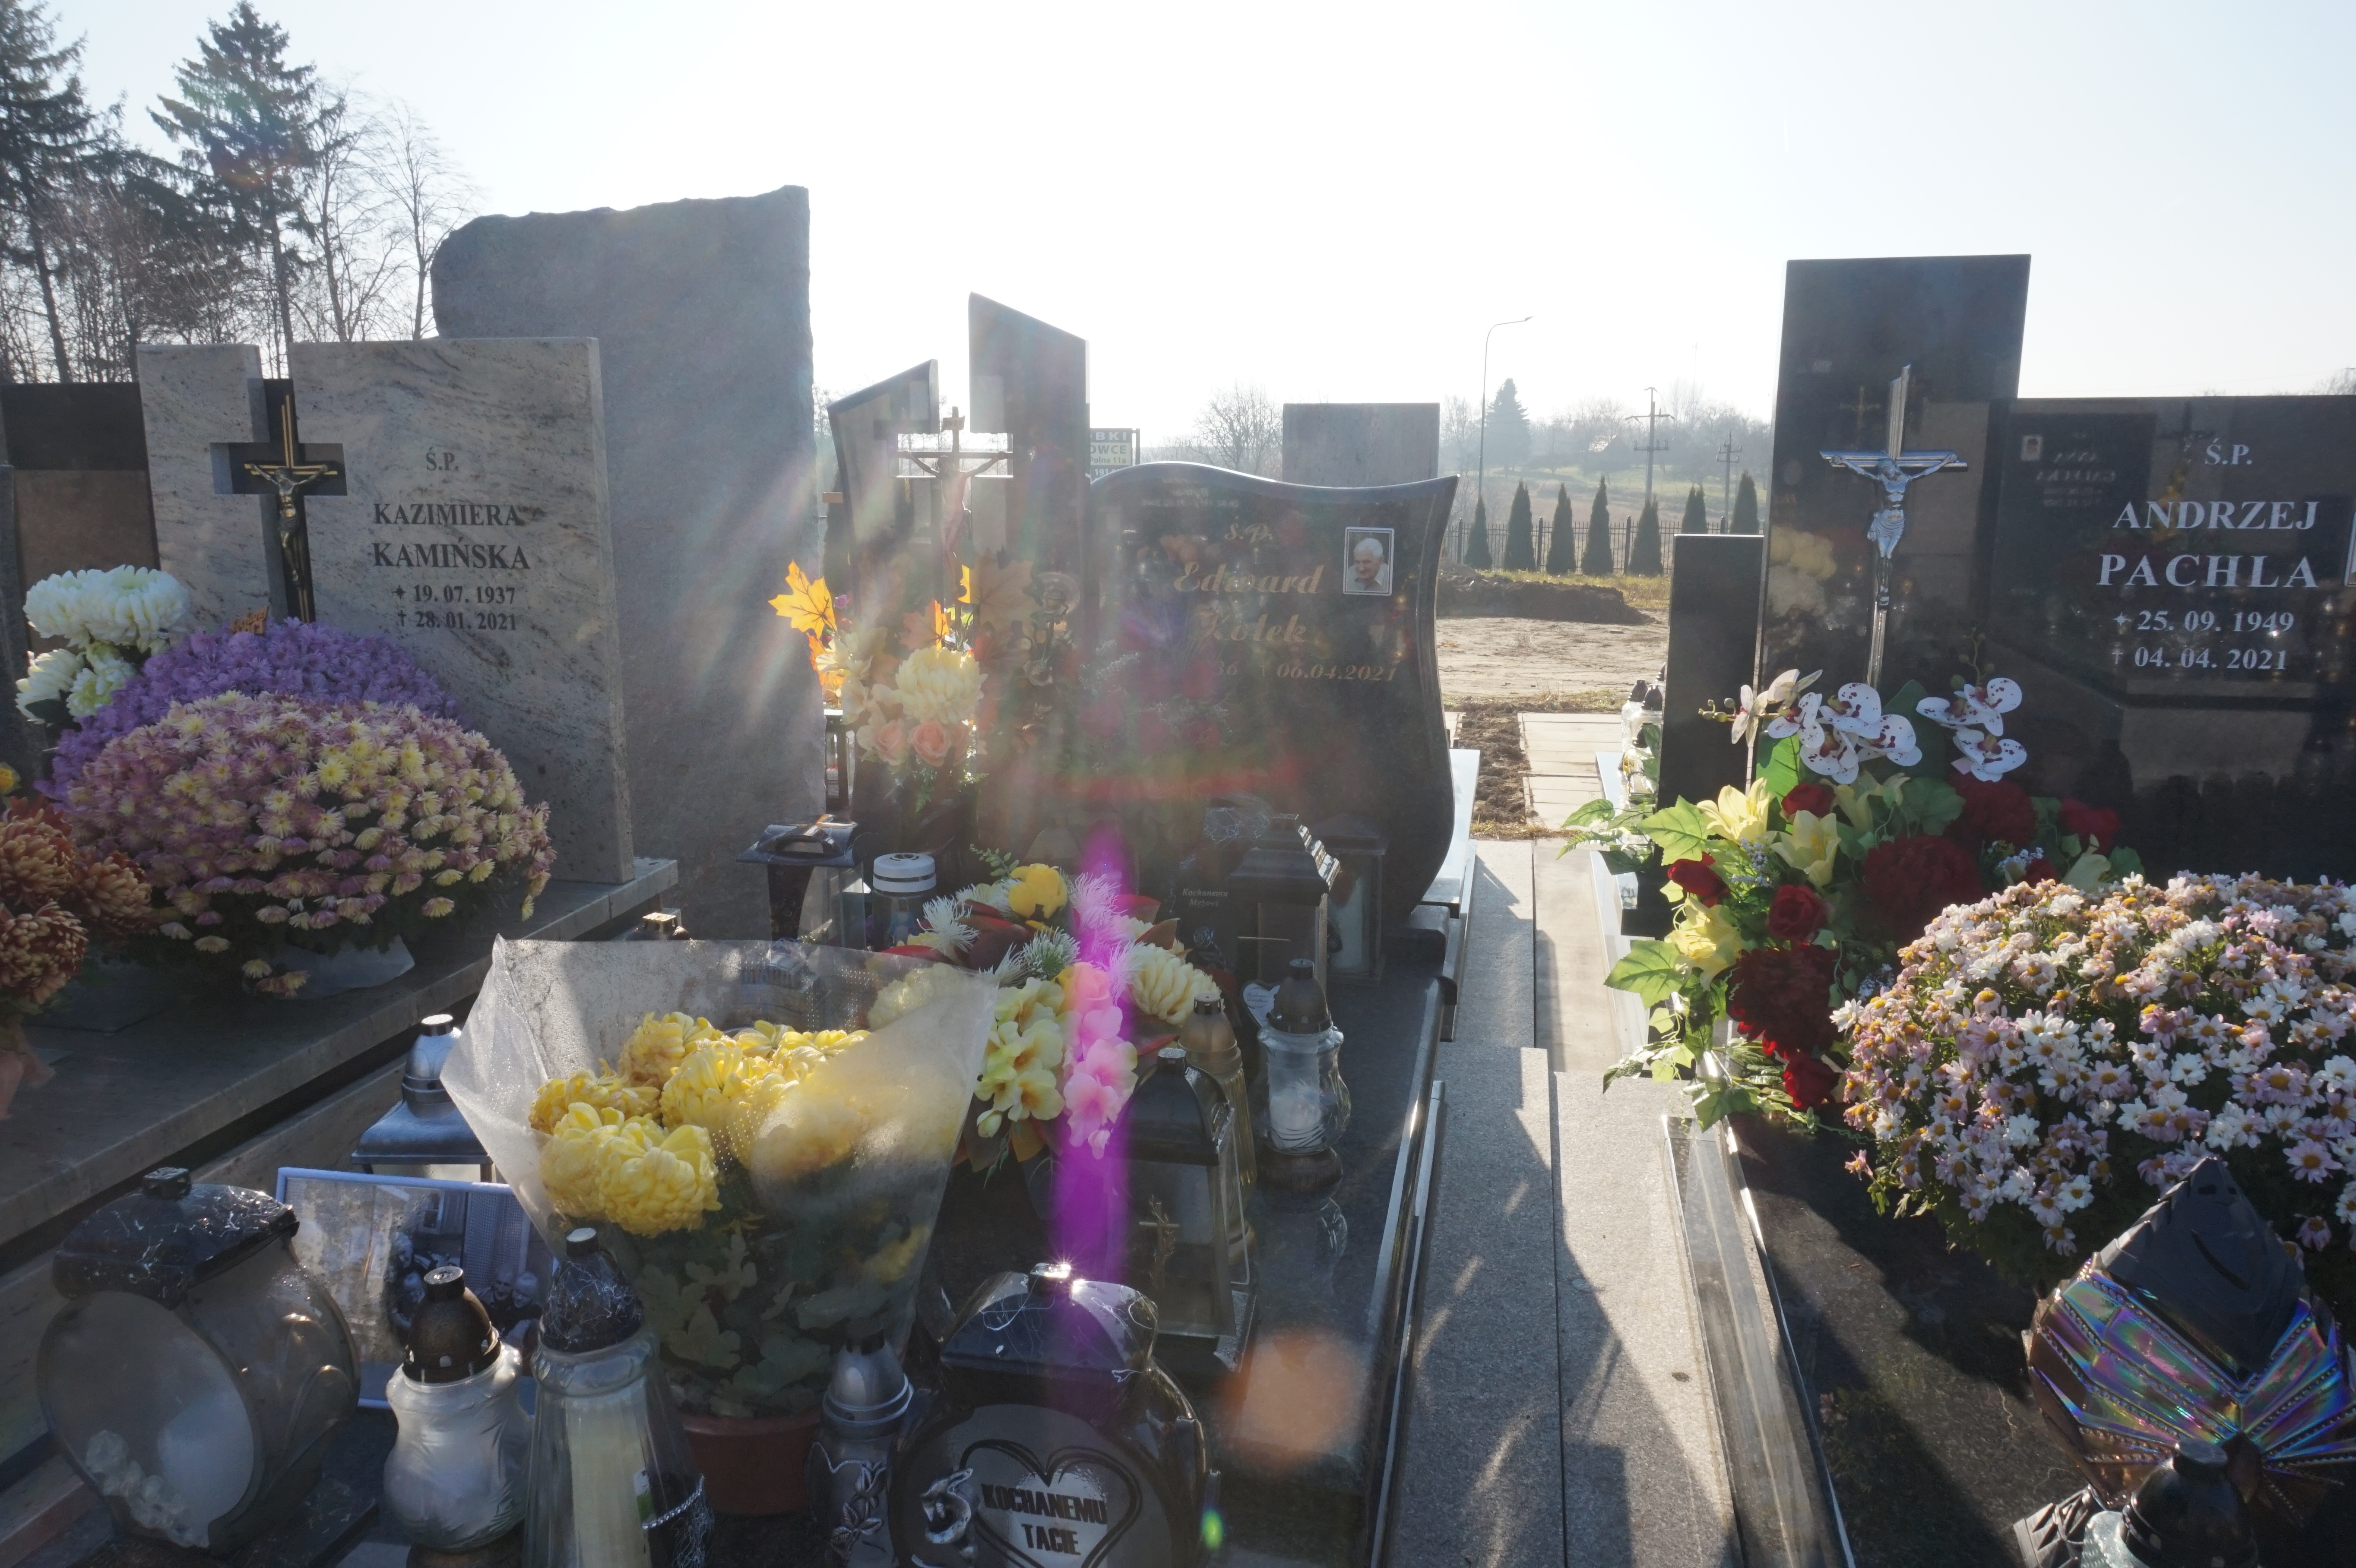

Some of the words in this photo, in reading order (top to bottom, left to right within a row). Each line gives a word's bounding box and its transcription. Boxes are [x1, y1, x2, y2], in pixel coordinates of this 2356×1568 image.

[1090, 432, 1126, 441] BKI
[425, 447, 459, 471] Ś.P.
[2204, 438, 2252, 465] Ś.P.
[373, 503, 526, 526] KAZIMIERA
[2112, 501, 2320, 530] ANDRZEJ
[372, 536, 531, 569] KAMIŃSKA
[1173, 562, 1325, 594] Edward
[2096, 554, 2318, 588] PACHLA
[476, 586, 516, 604] 1937
[477, 613, 517, 631] 2021
[2233, 611, 2294, 632] 1949
[2226, 649, 2287, 670] 2021
[1182, 888, 1228, 897] Kochanemu
[981, 1483, 1107, 1525] KOCHANEMU
[1021, 1524, 1081, 1555] TACIE
